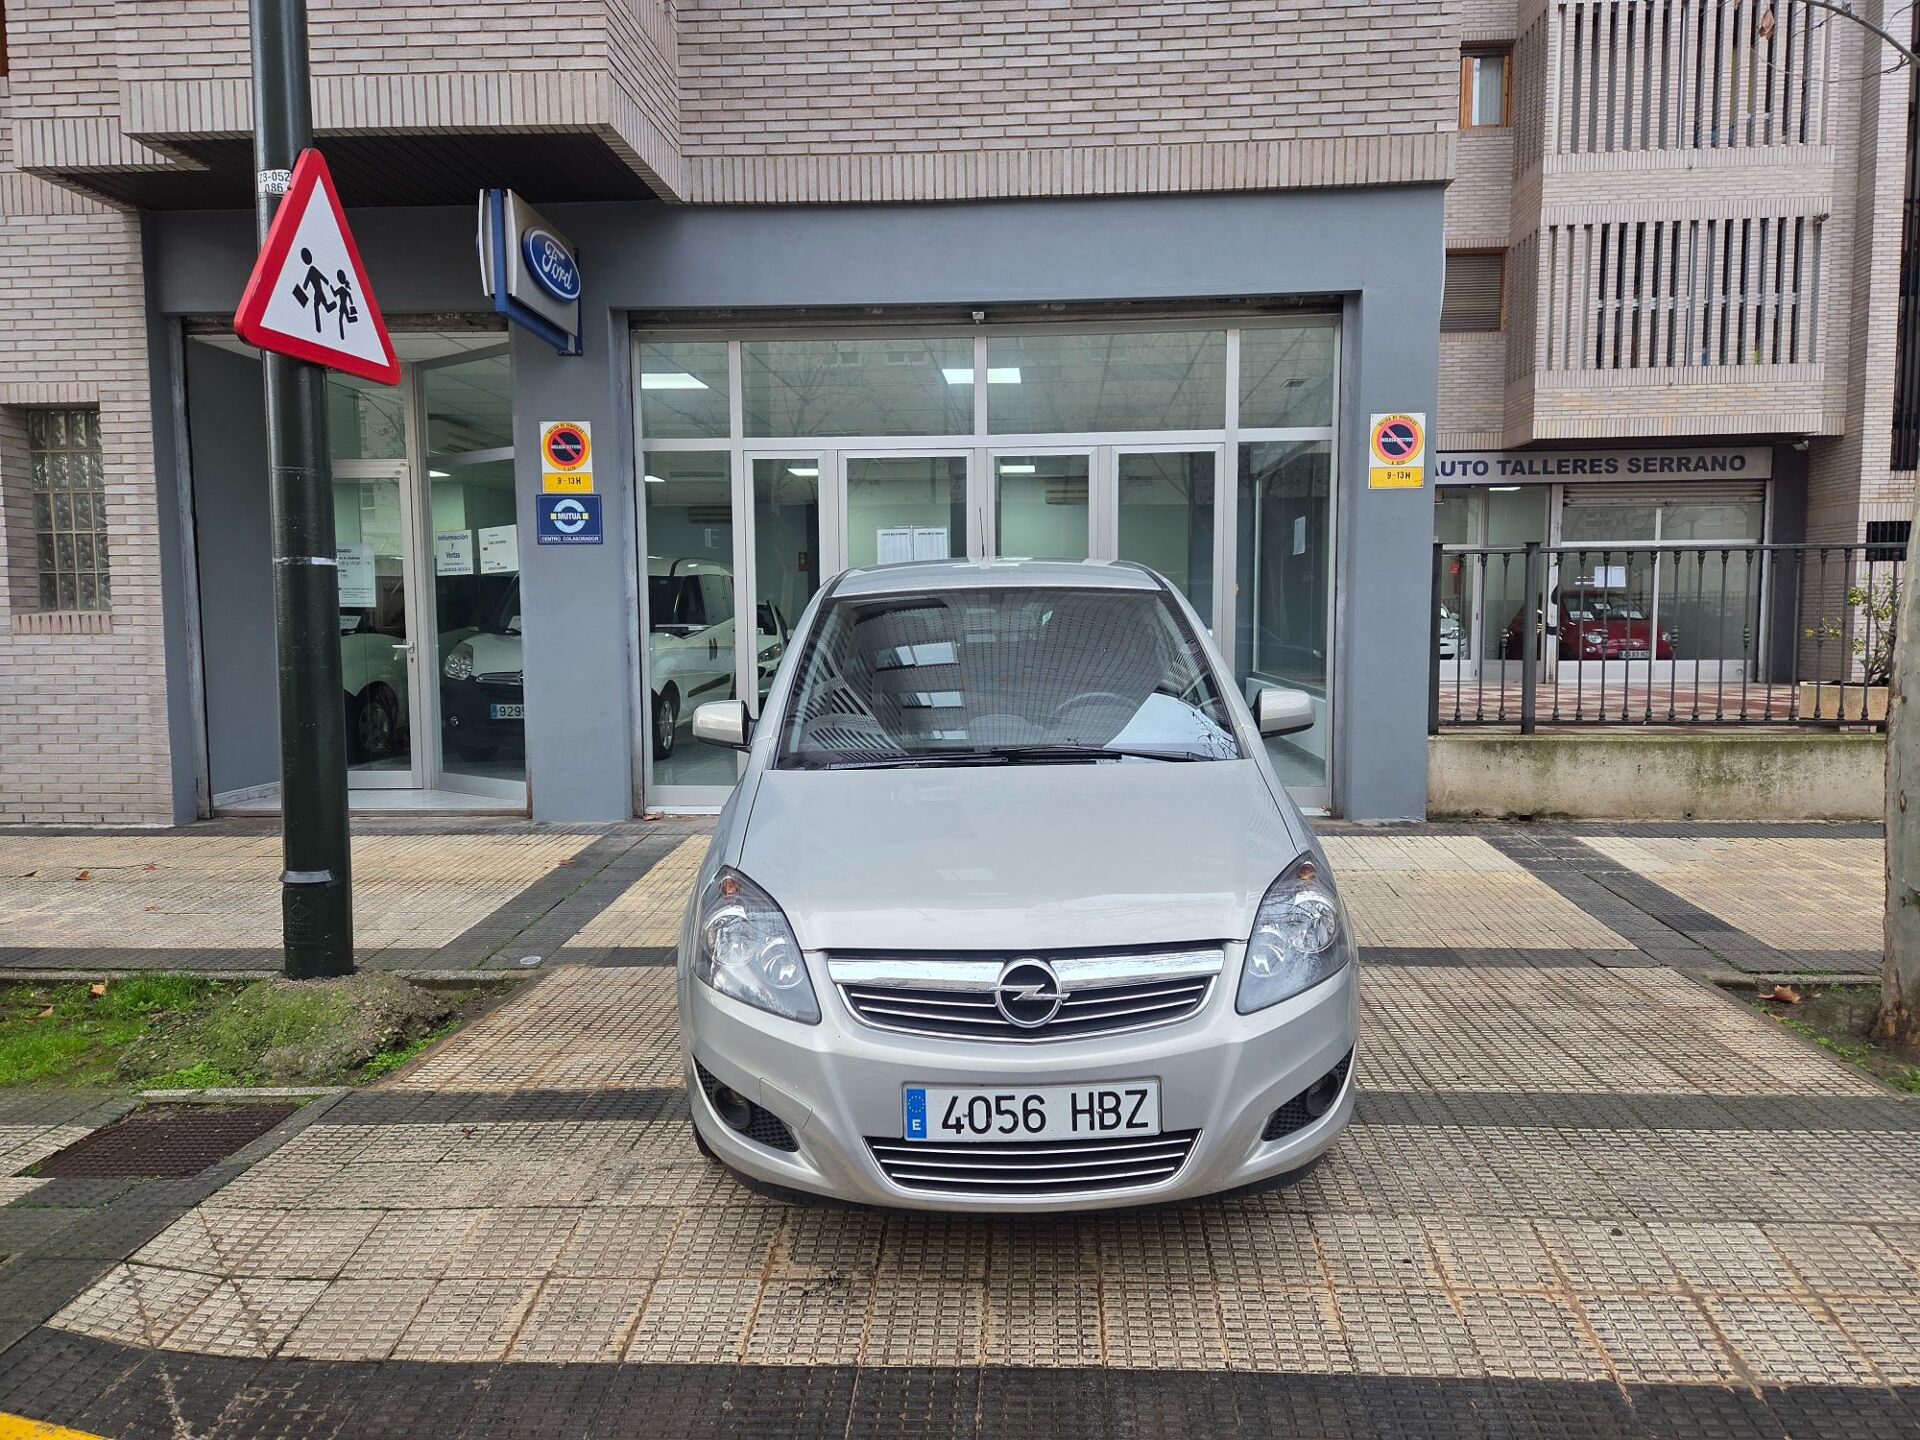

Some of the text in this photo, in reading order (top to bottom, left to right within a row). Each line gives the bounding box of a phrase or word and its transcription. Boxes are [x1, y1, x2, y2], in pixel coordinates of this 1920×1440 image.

[541, 240, 573, 290] Ford
[1496, 458, 1619, 476] TALLERES
[1626, 454, 1746, 474] SERRANO
[557, 512, 582, 520] MUTUA
[437, 533, 469, 541] Información
[445, 551, 461, 559] Ventas
[912, 1089, 1149, 1135] E 4056 HBZ
